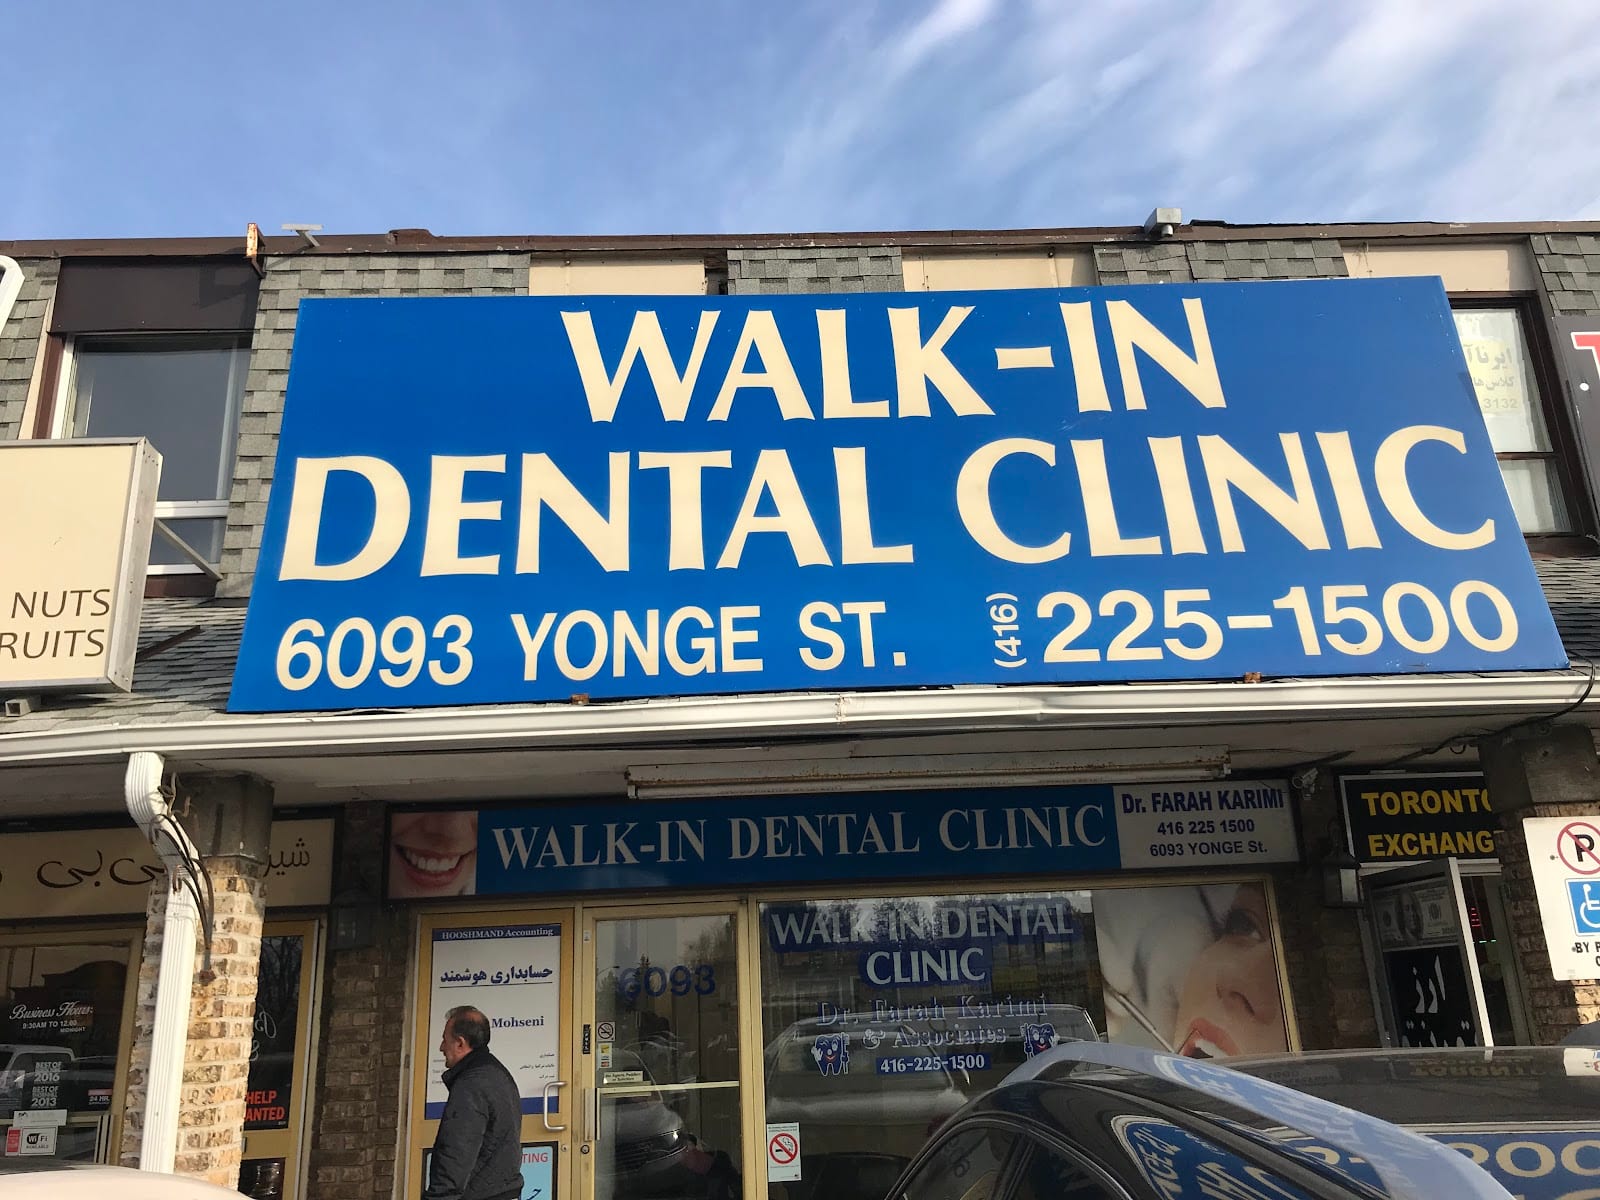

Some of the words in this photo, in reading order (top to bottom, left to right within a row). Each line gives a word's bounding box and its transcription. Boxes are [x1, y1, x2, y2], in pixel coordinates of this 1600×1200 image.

[560, 297, 1227, 423] WALK-IN
[278, 446, 914, 582] DENTAL
[956, 424, 1496, 565] CLINIC
[11, 588, 111, 619] NUTS
[276, 613, 474, 692] 6093
[512, 605, 764, 682] YONGE
[798, 600, 906, 672] ST.
[990, 590, 1028, 670] (416)
[1036, 580, 1519, 664] 225-1500
[1121, 793, 1147, 815] Dr.
[1151, 790, 1213, 814] FARAH
[1217, 787, 1285, 811] KARIMI
[1157, 819, 1185, 836] 416
[1188, 818, 1215, 835] 225
[1220, 817, 1256, 834] 1500
[491, 819, 707, 871] WALK-IN
[727, 811, 920, 860] DENTAL
[938, 804, 1107, 852] CLINIC
[1149, 840, 1185, 858] 6093
[1188, 839, 1242, 857] YONGE
[1246, 837, 1269, 854] St.
[442, 929, 504, 940] HOOSHMAND
[505, 927, 554, 937] Accounting
[771, 911, 875, 945] WALK
[942, 902, 1074, 940] DENTAL
[1574, 942, 1590, 954] BY
[440, 967, 487, 985] هوشمند
[490, 965, 553, 984] حسابداری
[866, 947, 986, 986] CLINIC
[620, 964, 716, 1000] 6093
[9, 1004, 55, 1020] Business
[869, 995, 946, 1024] Farah
[957, 992, 1048, 1021] Karimi
[48, 1020, 59, 1029] TO
[491, 1015, 545, 1029] Mohseni
[862, 1028, 886, 1050] &
[892, 1023, 1008, 1049] Associates
[880, 1054, 985, 1074] 416-225-1500
[34, 1072, 61, 1083] 2016
[31, 1097, 57, 1108] 2013
[245, 1090, 278, 1105] HELP
